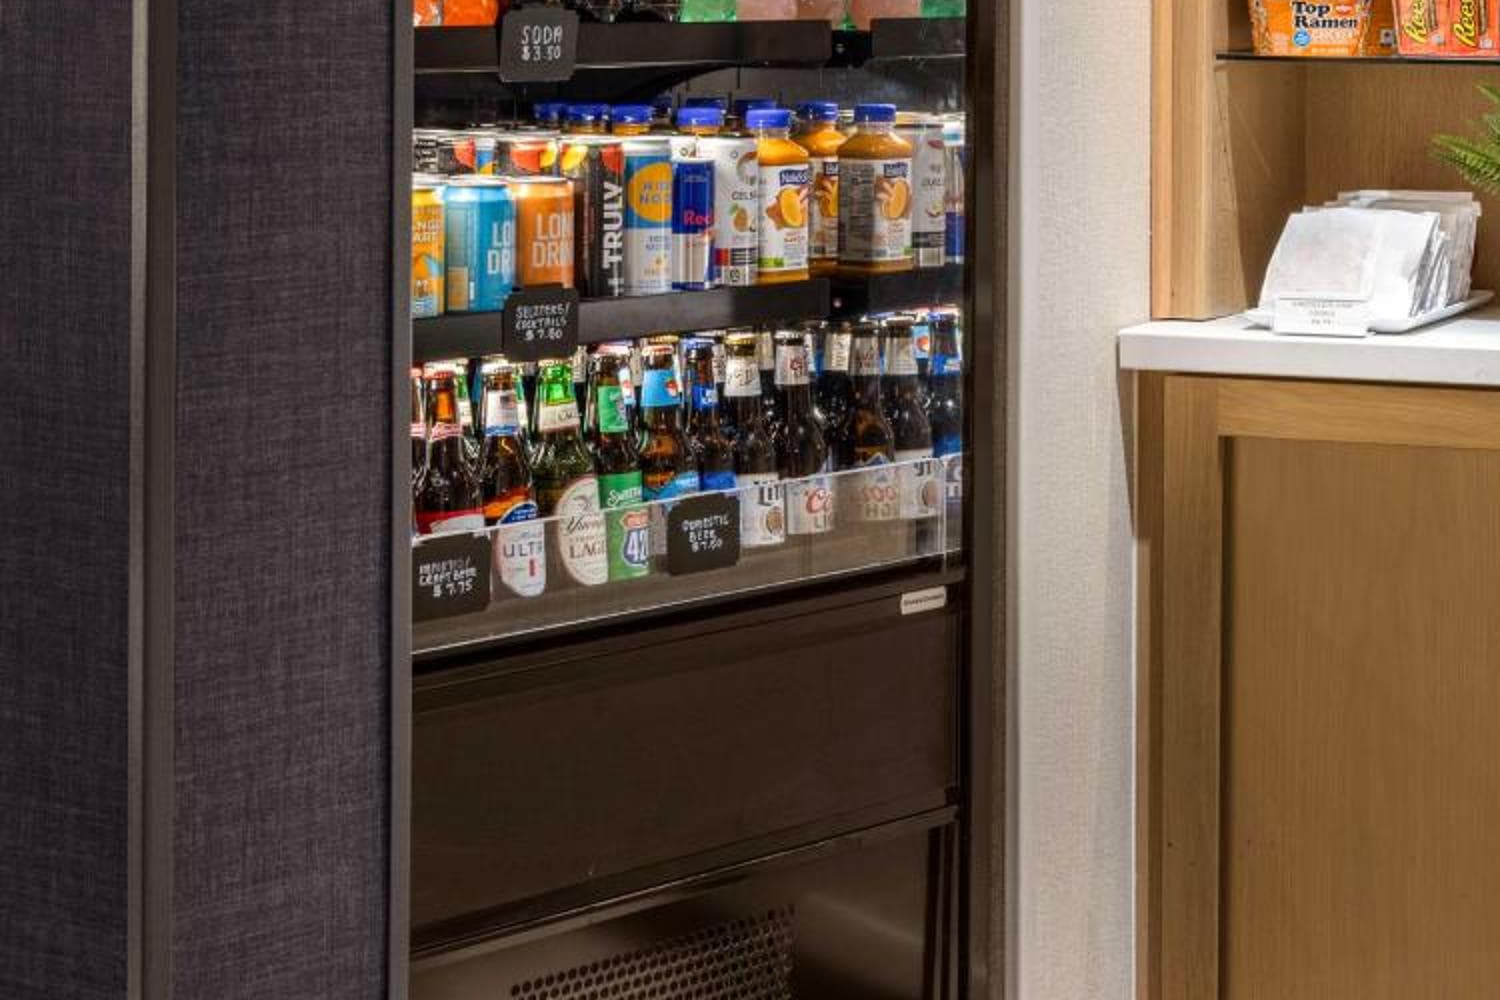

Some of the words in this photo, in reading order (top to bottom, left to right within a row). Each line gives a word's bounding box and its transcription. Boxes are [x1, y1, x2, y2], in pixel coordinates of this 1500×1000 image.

[1292, 1, 1331, 16] Top
[1293, 15, 1358, 29] Ramen
[520, 25, 563, 45] SODA
[521, 45, 562, 62] $3.50
[602, 181, 624, 269] TRULY
